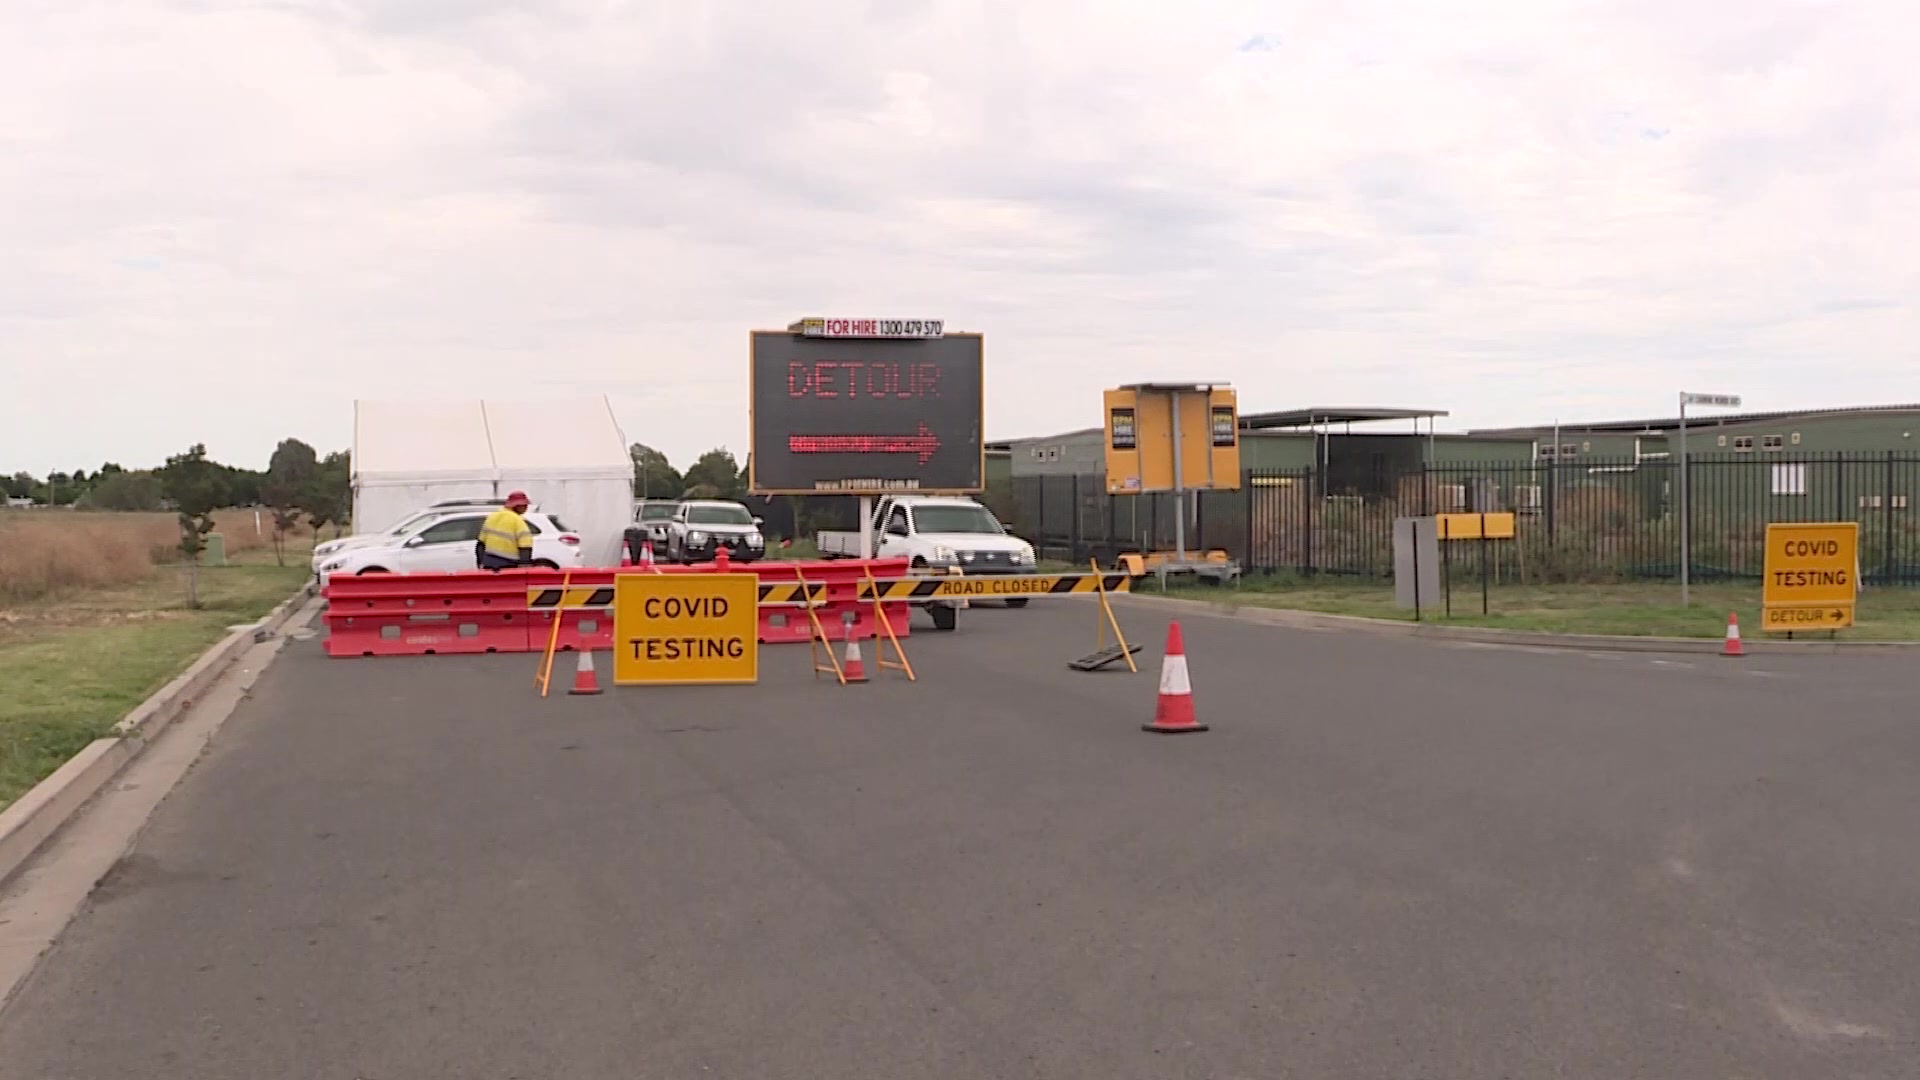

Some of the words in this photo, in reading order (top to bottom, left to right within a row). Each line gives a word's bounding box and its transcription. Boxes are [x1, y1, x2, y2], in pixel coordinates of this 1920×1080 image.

[827, 320, 849, 335] FOR
[852, 320, 877, 335] HIRE
[880, 320, 901, 335] 1300
[904, 320, 922, 335] 479
[924, 320, 942, 335] 570
[789, 361, 940, 397] DETOUR
[1784, 541, 1838, 556] COVID
[1774, 570, 1847, 586] TESTING
[943, 582, 984, 594] ROAD
[992, 580, 1049, 593] CLOSED
[645, 598, 728, 618] COVID
[1770, 610, 1823, 622] DETOUR
[629, 637, 743, 659] TESTING
